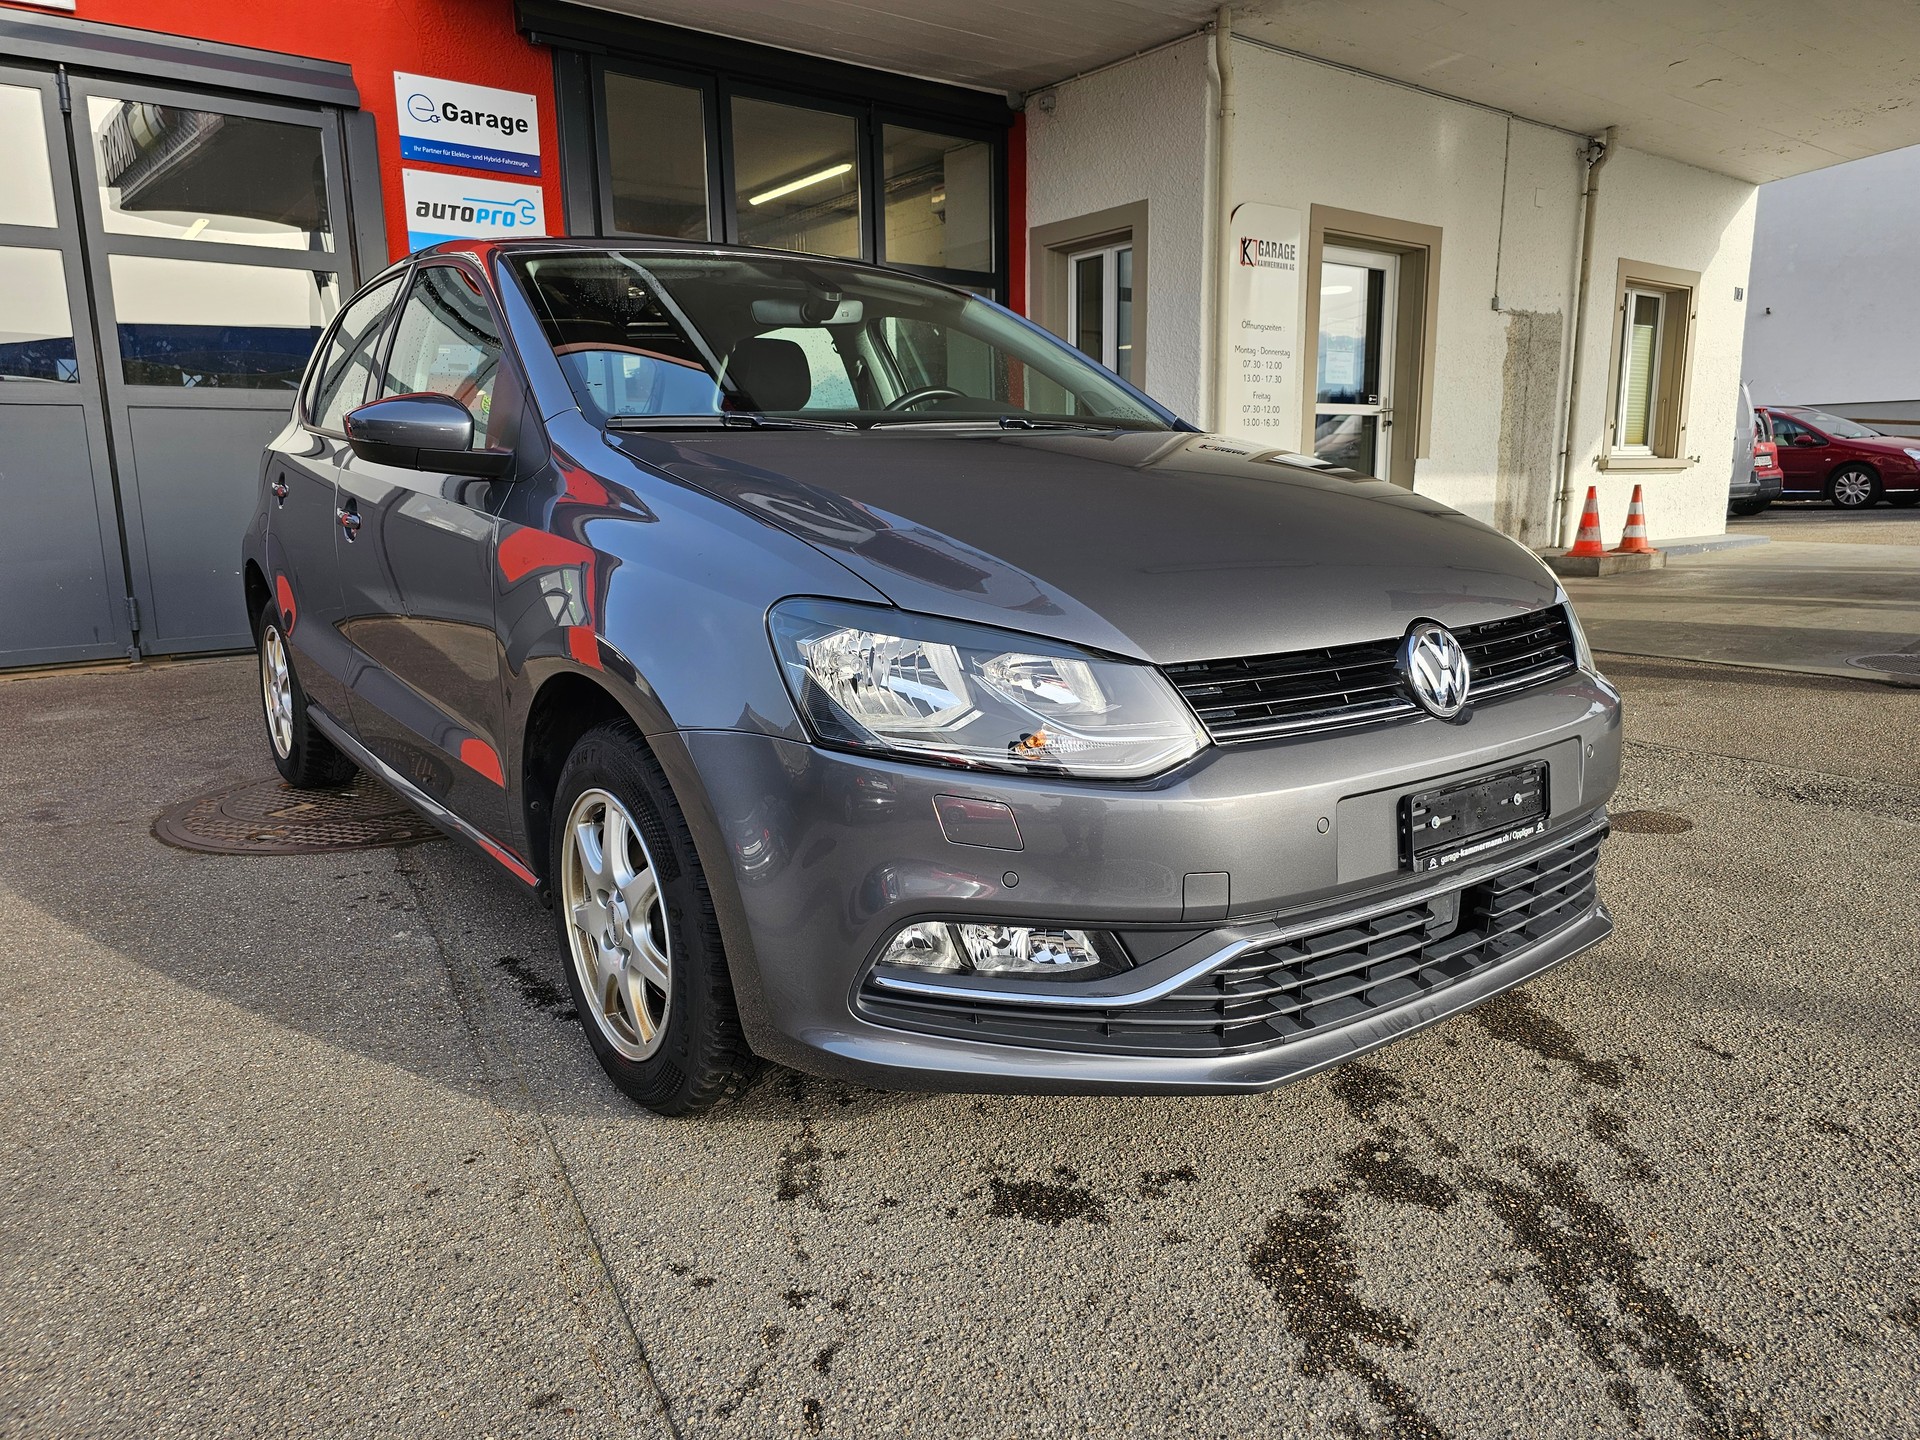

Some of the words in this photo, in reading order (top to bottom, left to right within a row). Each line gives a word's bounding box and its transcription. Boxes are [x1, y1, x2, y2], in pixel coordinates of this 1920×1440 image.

[442, 102, 528, 136] Garage
[422, 146, 443, 155] Partner
[442, 148, 451, 156] für
[451, 150, 472, 159] Elektro-
[1258, 240, 1295, 261] GARAGE
[1289, 263, 1295, 271] AG
[1234, 345, 1256, 357] Montag
[1260, 346, 1291, 359] Donnerstag
[1242, 360, 1261, 369] 07.30
[1265, 361, 1282, 370] 12.00
[1243, 374, 1261, 383] 13.00
[1265, 375, 1282, 384] 17.30
[1252, 391, 1271, 402] Freitag
[1242, 404, 1260, 413] 07.30
[1243, 418, 1260, 427] 13.00
